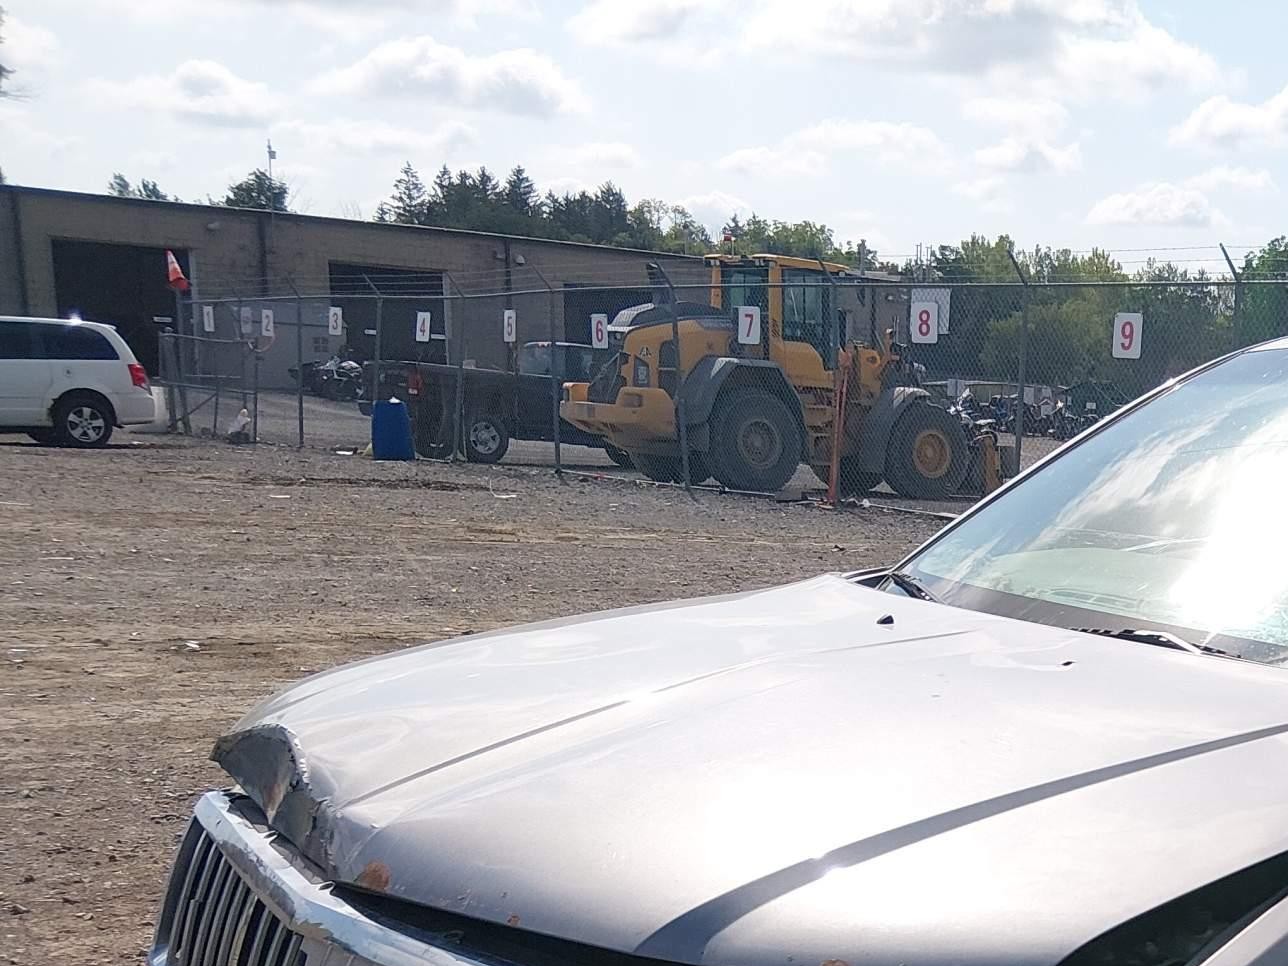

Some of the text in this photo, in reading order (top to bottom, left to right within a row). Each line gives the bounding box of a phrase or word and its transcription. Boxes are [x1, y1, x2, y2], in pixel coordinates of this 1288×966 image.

[264, 314, 271, 332] 2
[332, 312, 339, 330] 3
[419, 317, 426, 336] 4
[506, 316, 513, 337] 5
[595, 320, 603, 343] 6
[744, 313, 754, 337] 7
[918, 309, 931, 337] 8
[1120, 321, 1134, 351] 9
